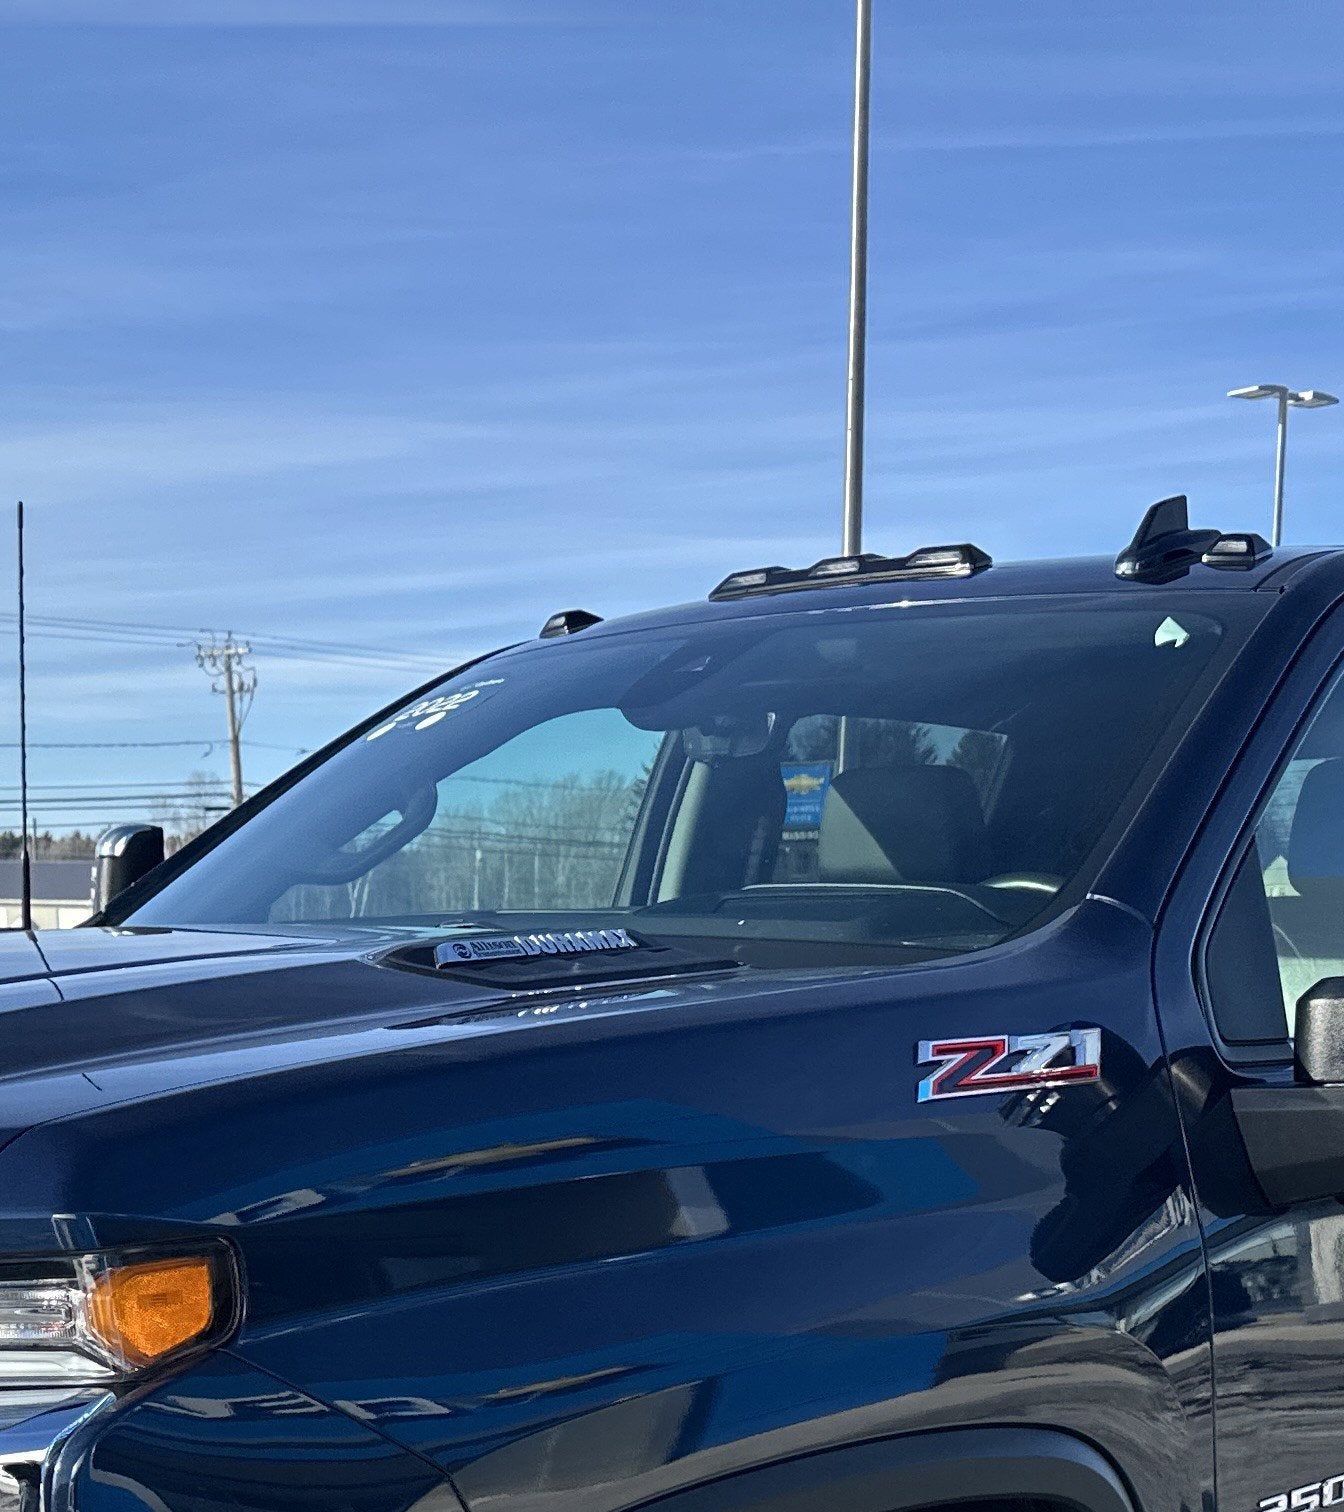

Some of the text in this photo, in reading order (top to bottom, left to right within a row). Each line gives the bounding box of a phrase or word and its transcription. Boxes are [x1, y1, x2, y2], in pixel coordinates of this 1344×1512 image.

[394, 690, 479, 722] 2022
[513, 929, 639, 957] DURAMAX
[917, 1028, 1102, 1103] Z71
